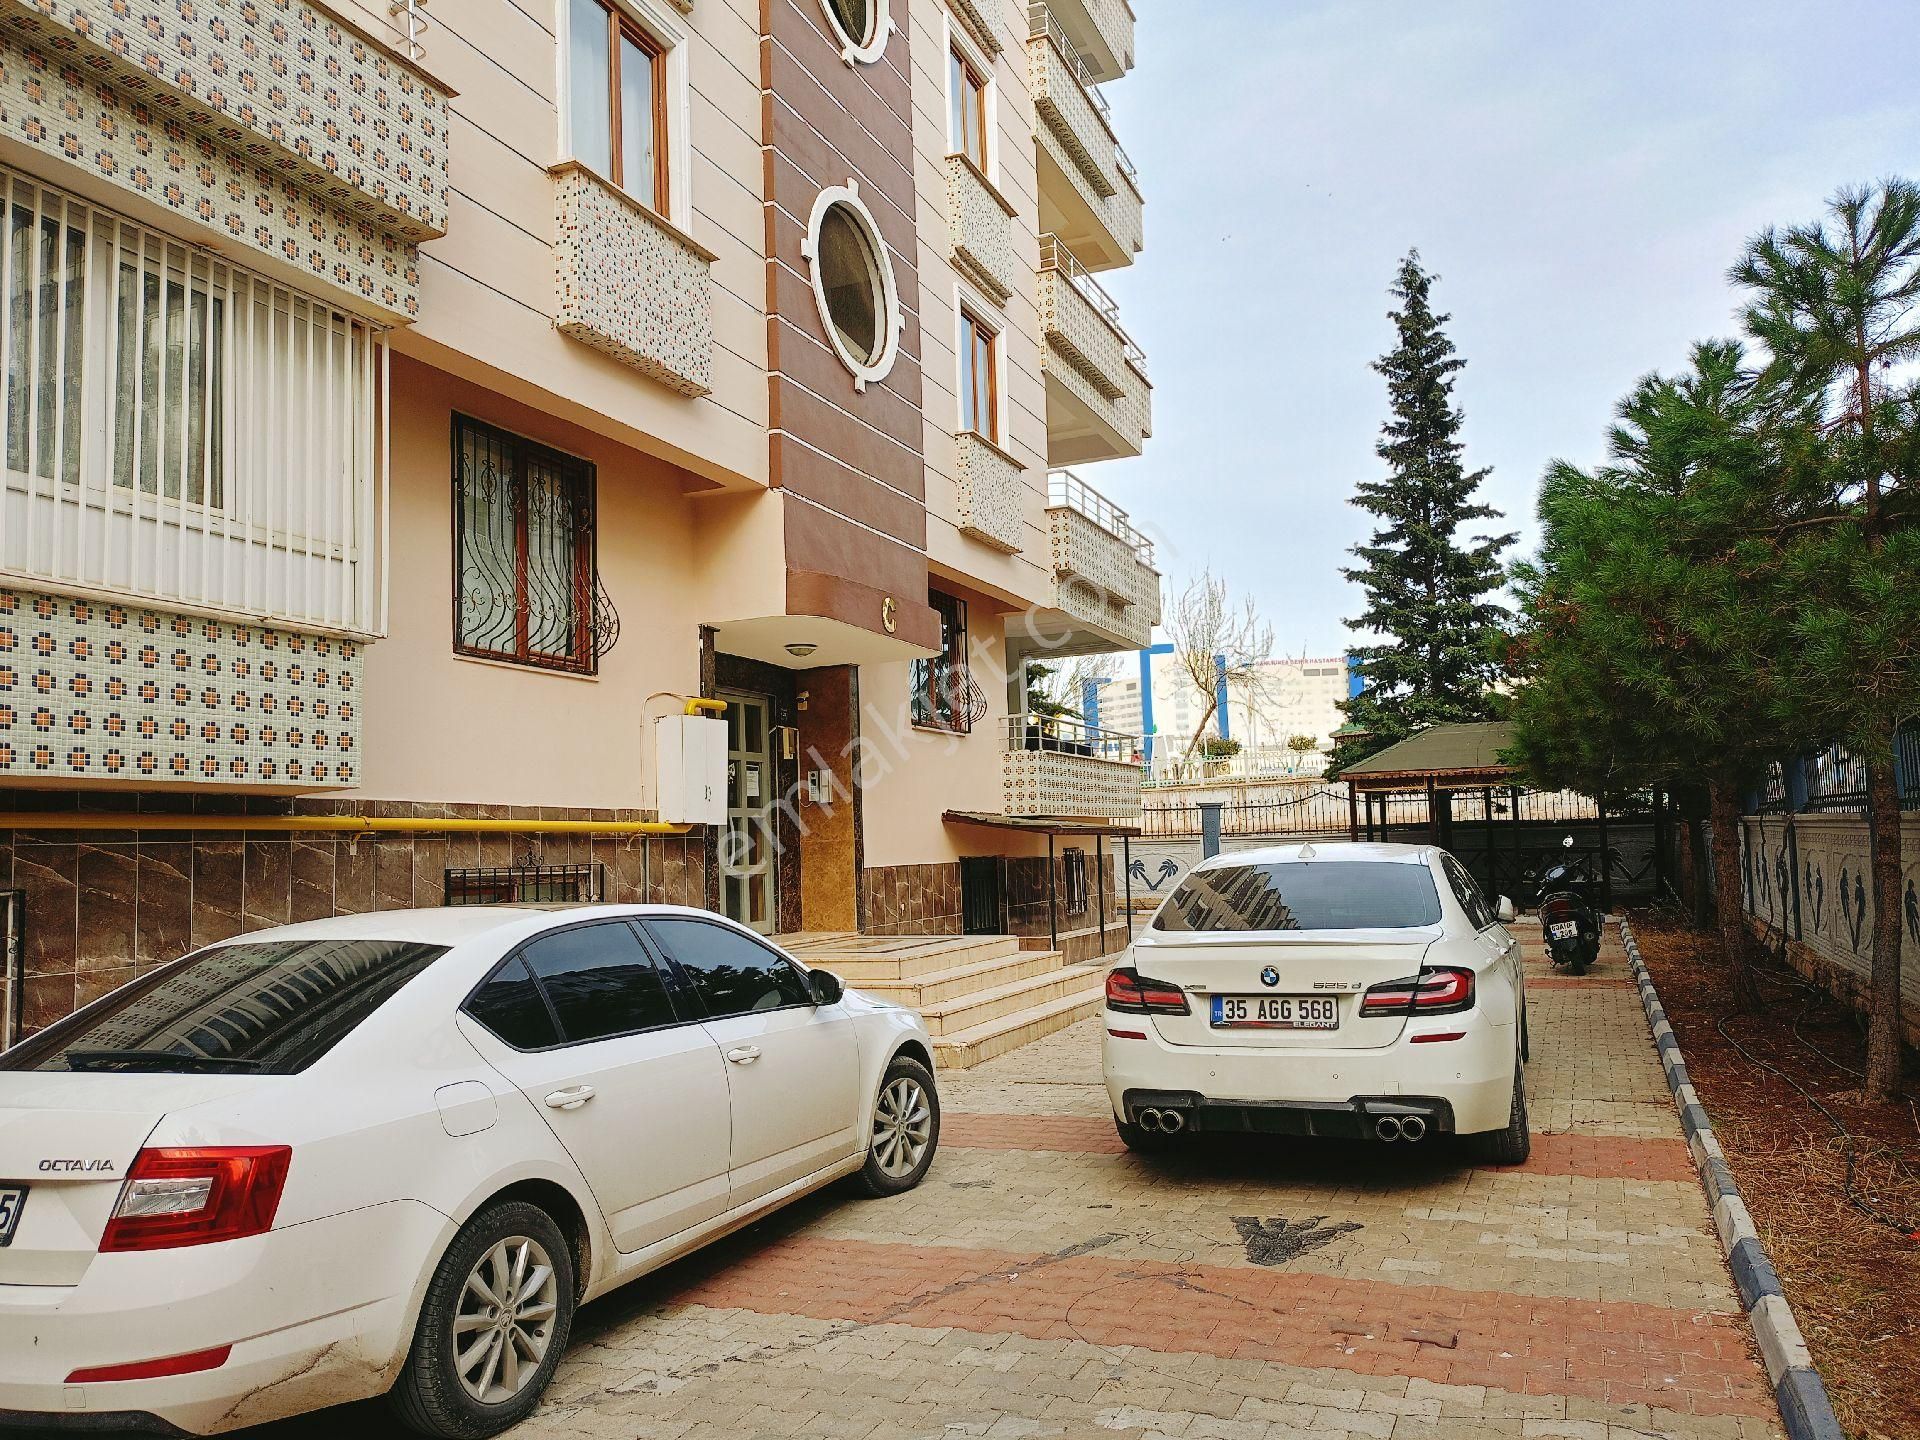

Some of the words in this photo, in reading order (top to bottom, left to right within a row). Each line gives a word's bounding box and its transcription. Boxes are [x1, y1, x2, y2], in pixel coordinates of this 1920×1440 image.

[882, 596, 897, 634] C
[1225, 999, 1247, 1019] 35
[1257, 999, 1292, 1019] AGG
[1298, 999, 1333, 1020] 568
[38, 1159, 115, 1171] OCTAVIA
